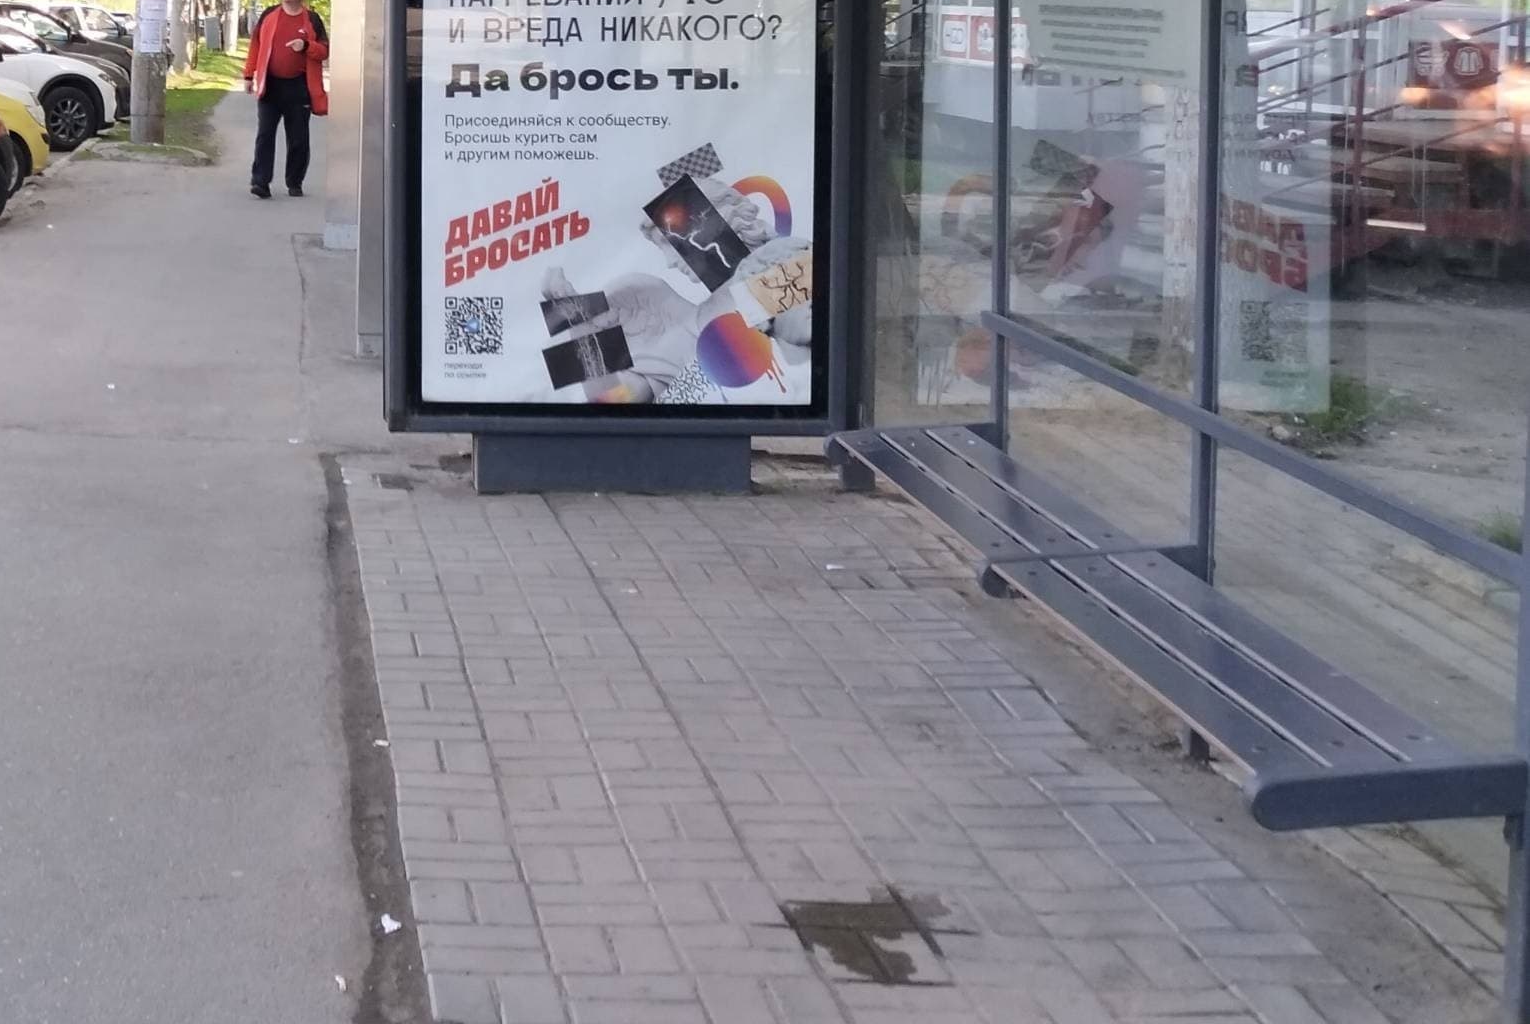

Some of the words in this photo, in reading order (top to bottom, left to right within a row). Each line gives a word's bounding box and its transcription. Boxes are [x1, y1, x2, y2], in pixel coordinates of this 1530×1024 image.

[449, 18, 465, 43] И
[483, 17, 583, 47] ВРЕДА
[601, 15, 783, 43] НИКАКОГО?
[445, 63, 510, 97] Да
[520, 62, 660, 99] брось
[667, 67, 739, 91] ты.
[445, 114, 562, 128] Присоединяйся
[566, 117, 575, 126] к
[579, 114, 671, 128] сообществу.
[444, 131, 510, 145] Бросишь
[515, 133, 565, 147] курить
[569, 133, 598, 143] сам
[445, 151, 453, 160] и
[457, 150, 510, 163] другим
[514, 150, 599, 161] поможешь.
[444, 177, 560, 255] ДАВАЙ
[444, 210, 591, 288] БРОСАТЬ
